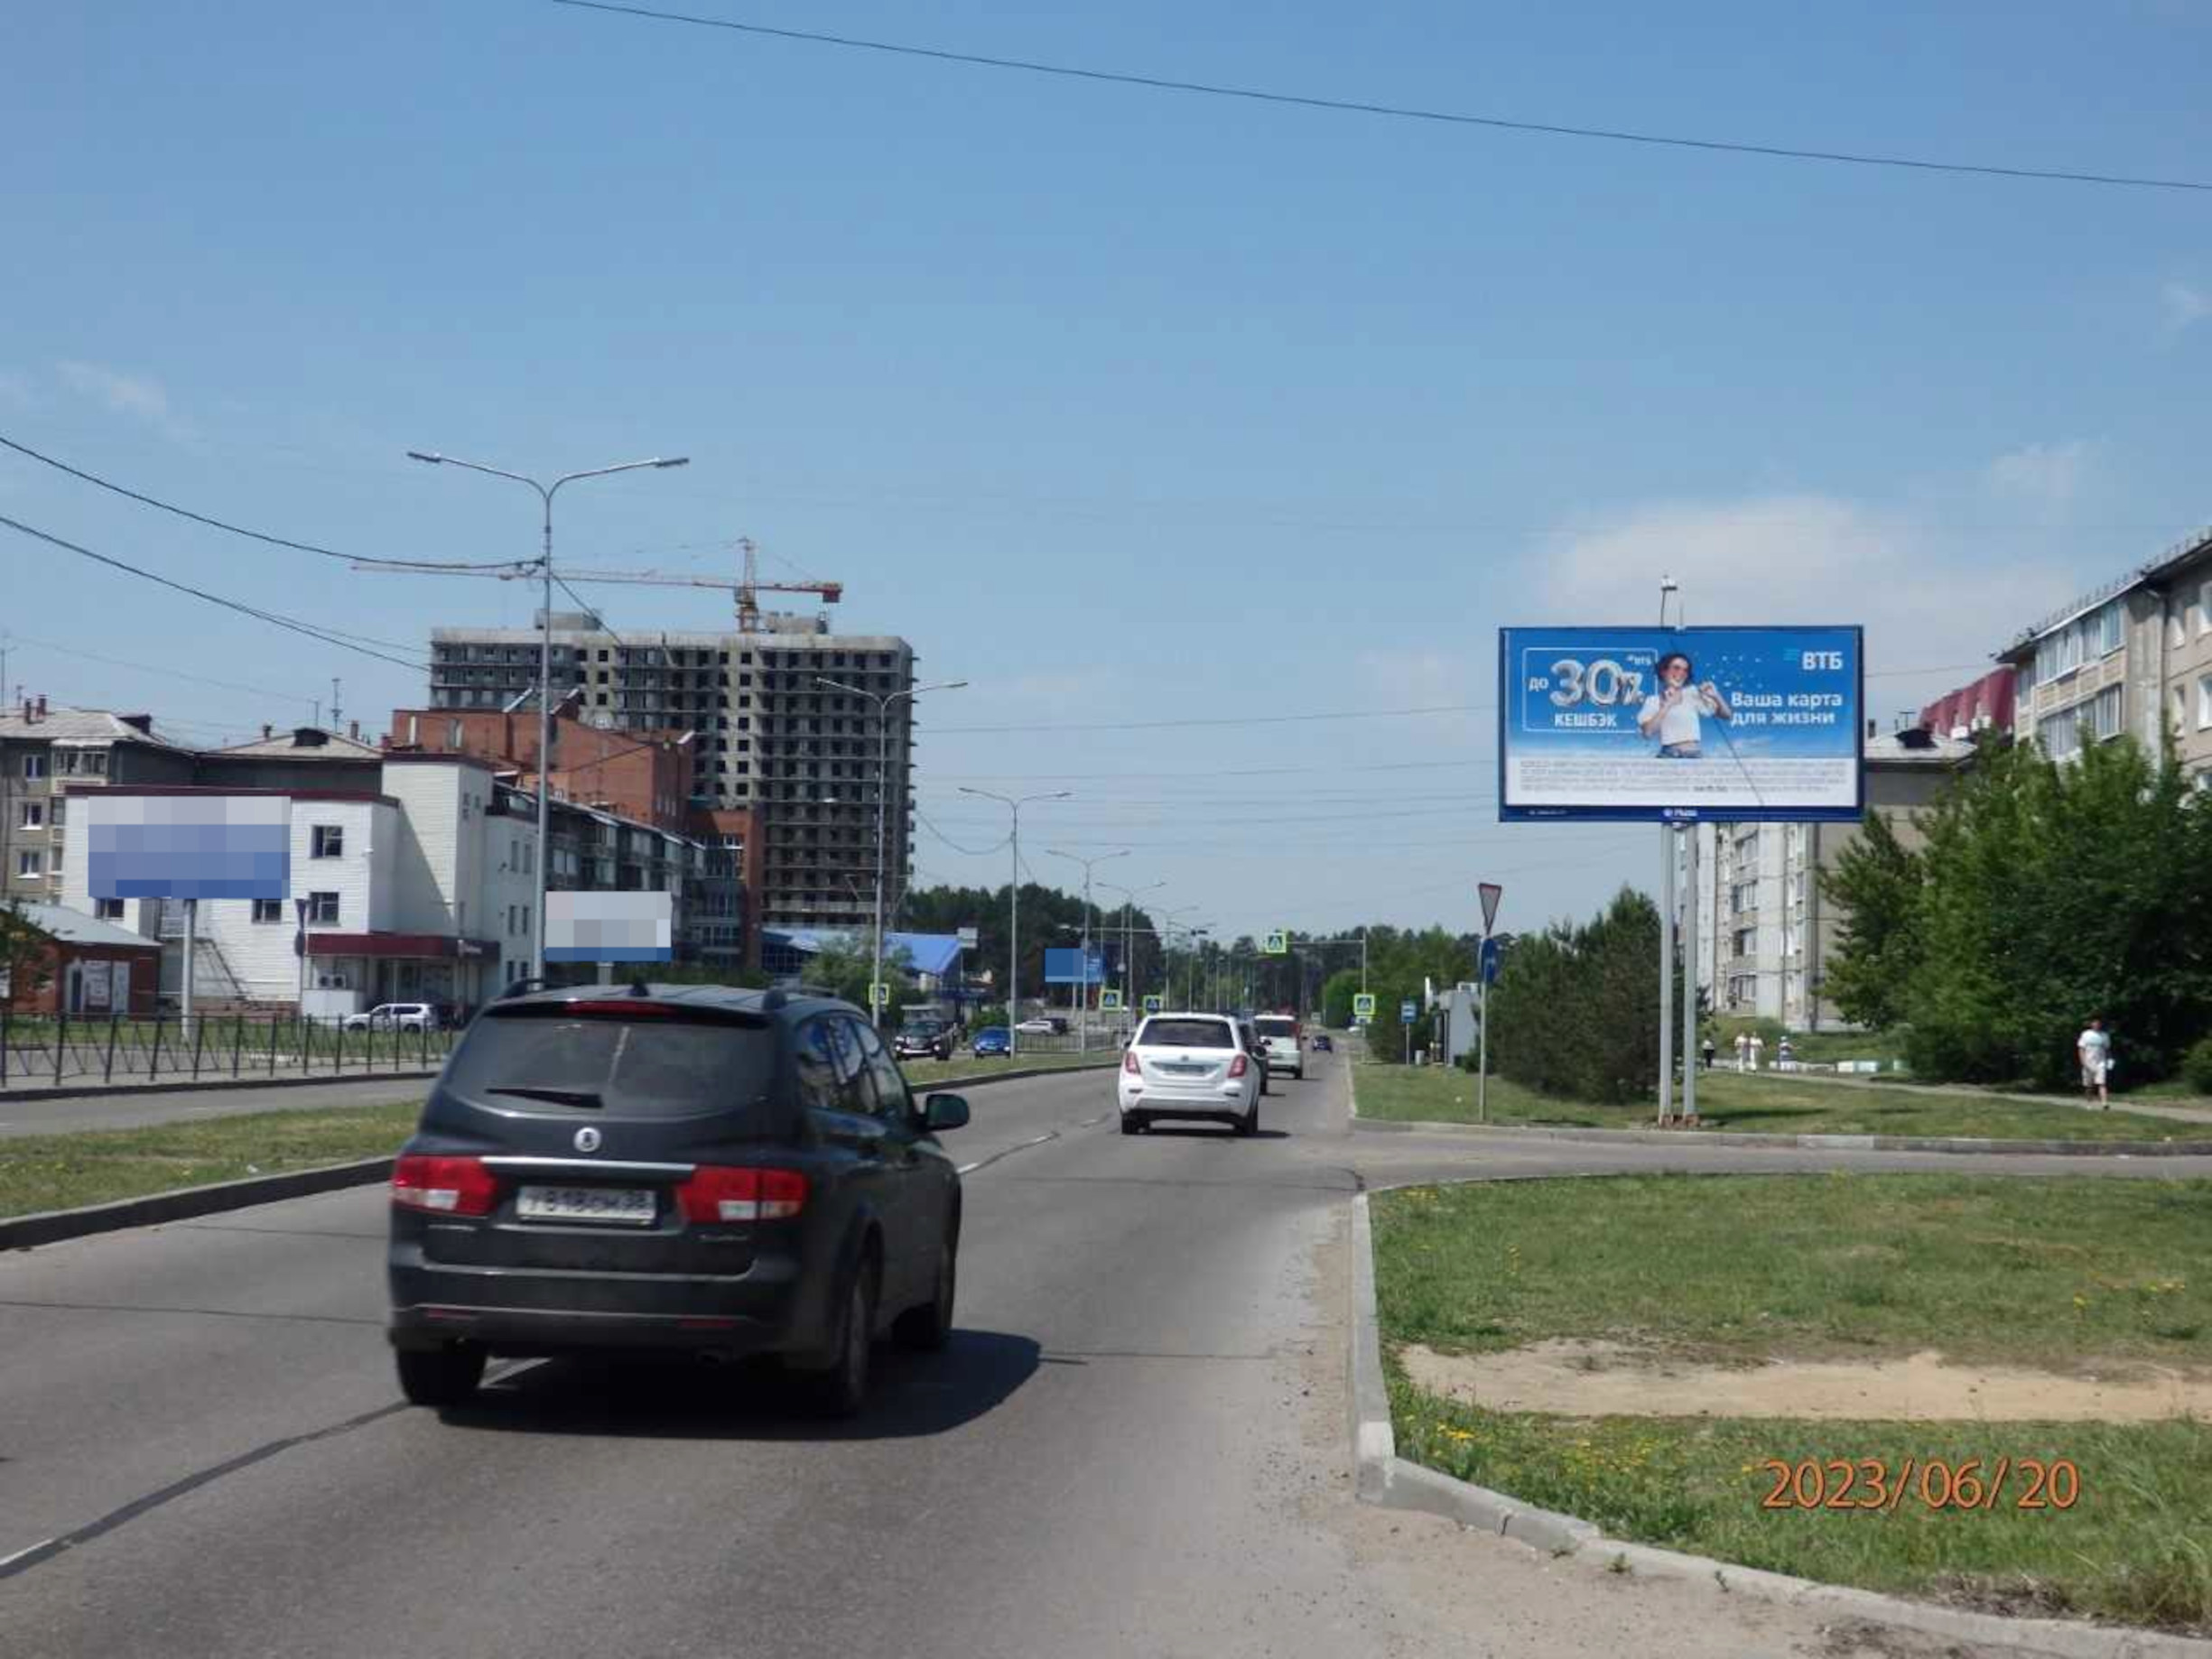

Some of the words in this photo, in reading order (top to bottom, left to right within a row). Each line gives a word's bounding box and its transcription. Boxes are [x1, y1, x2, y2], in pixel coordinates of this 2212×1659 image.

[1802, 651, 1843, 670] ВТБ
[1731, 691, 1783, 707] Ваша
[1788, 693, 1843, 710] карта
[1554, 712, 1617, 727] КЕШБЭК
[1731, 712, 1767, 728] для
[1771, 712, 1836, 724] жизни
